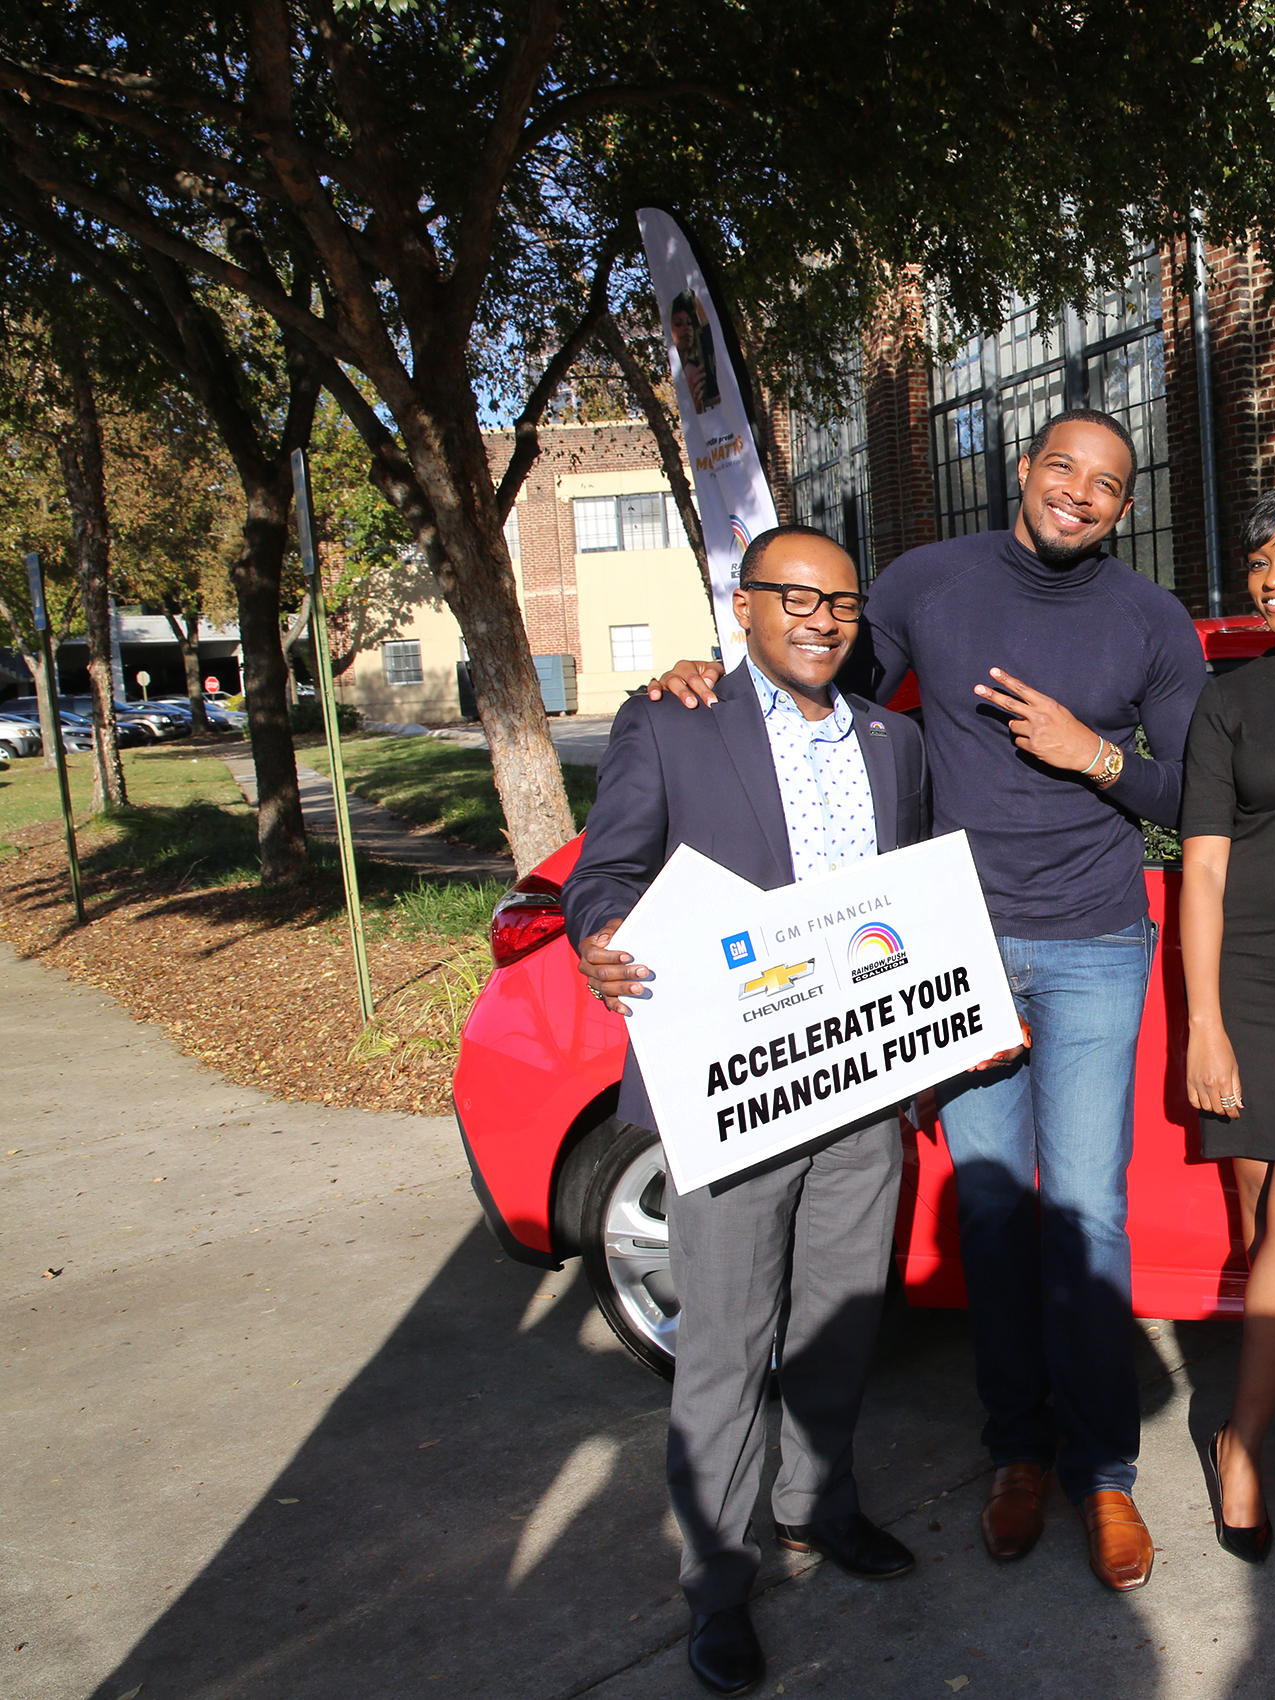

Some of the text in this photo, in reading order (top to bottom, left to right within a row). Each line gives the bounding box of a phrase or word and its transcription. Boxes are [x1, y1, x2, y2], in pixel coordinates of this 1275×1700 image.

[775, 894, 892, 943] GM FINANCIAL
[729, 939, 749, 957] GM
[851, 958, 885, 977] RAINBOW
[855, 960, 905, 982] COALITION
[743, 985, 824, 1023] CHEVROLET
[706, 966, 971, 1097] ACCELERATE YOUR
[716, 1004, 983, 1143] FINANCIAL FUTURE
